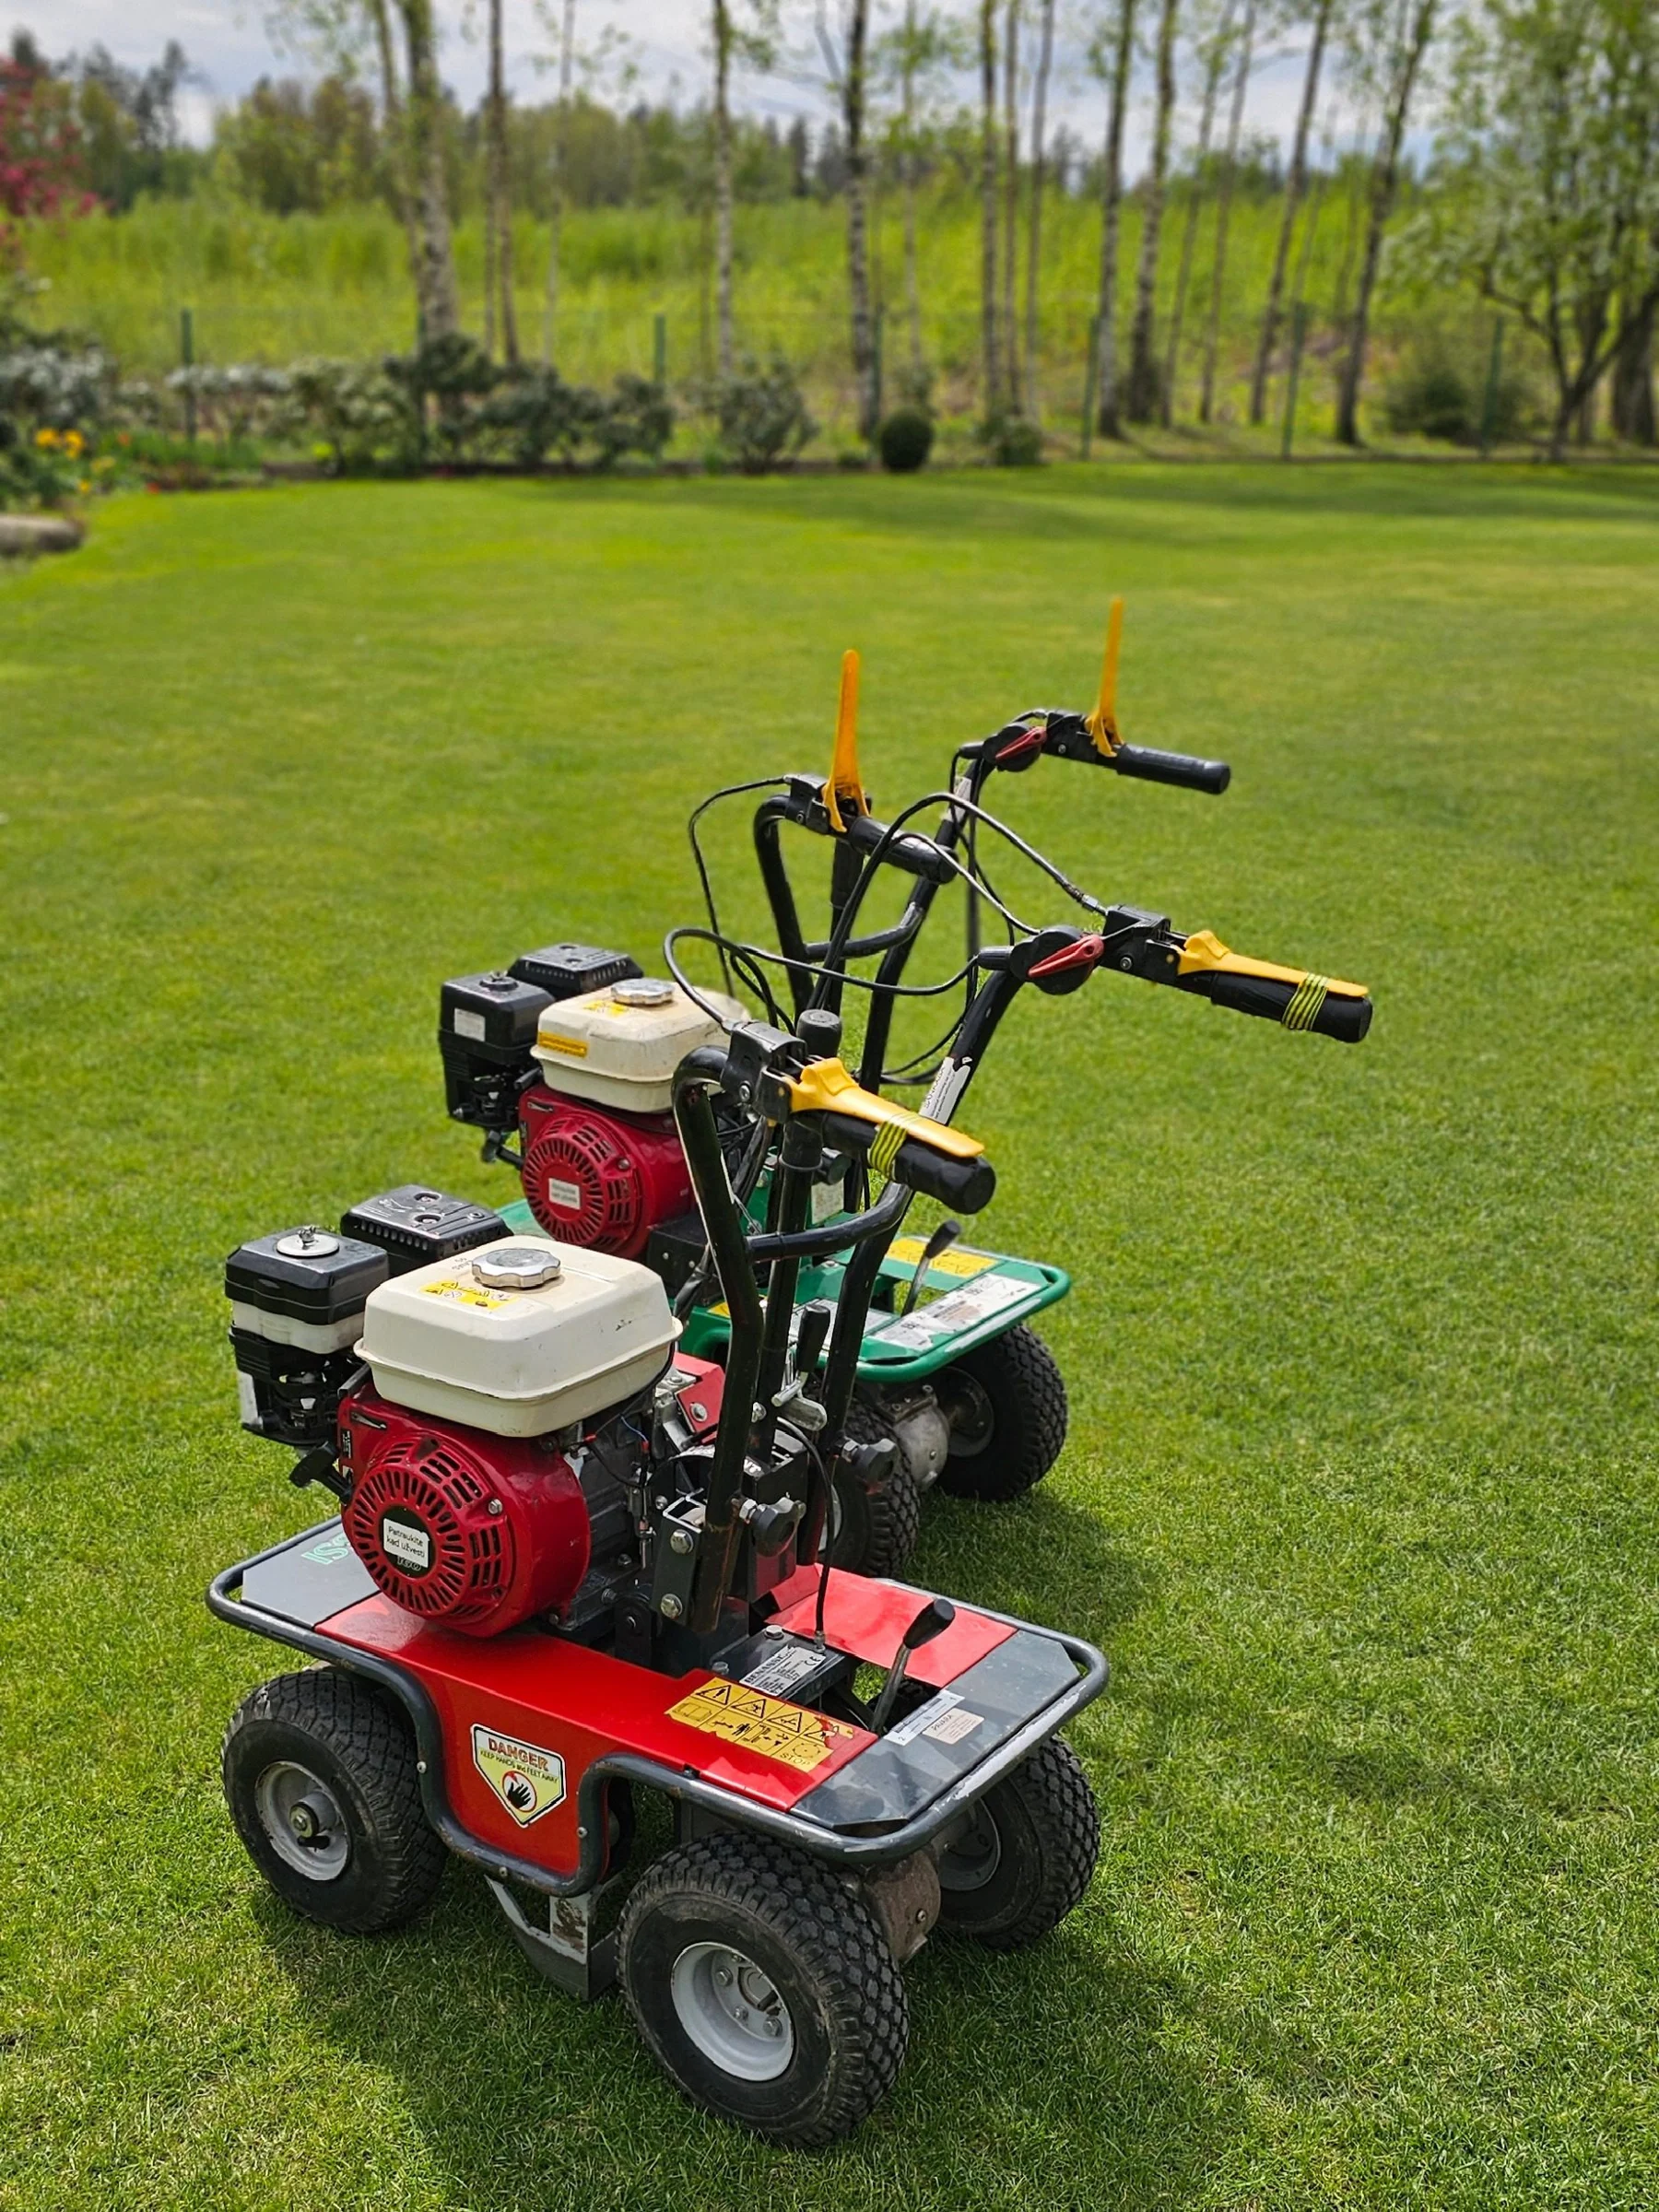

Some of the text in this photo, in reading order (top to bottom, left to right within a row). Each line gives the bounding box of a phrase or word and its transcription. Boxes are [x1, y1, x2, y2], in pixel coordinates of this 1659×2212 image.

[480, 1749, 495, 1759] KEEP
[526, 1766, 541, 1779] FEET
[488, 1737, 549, 1771] DANGER
[780, 1752, 811, 1766] STOP
